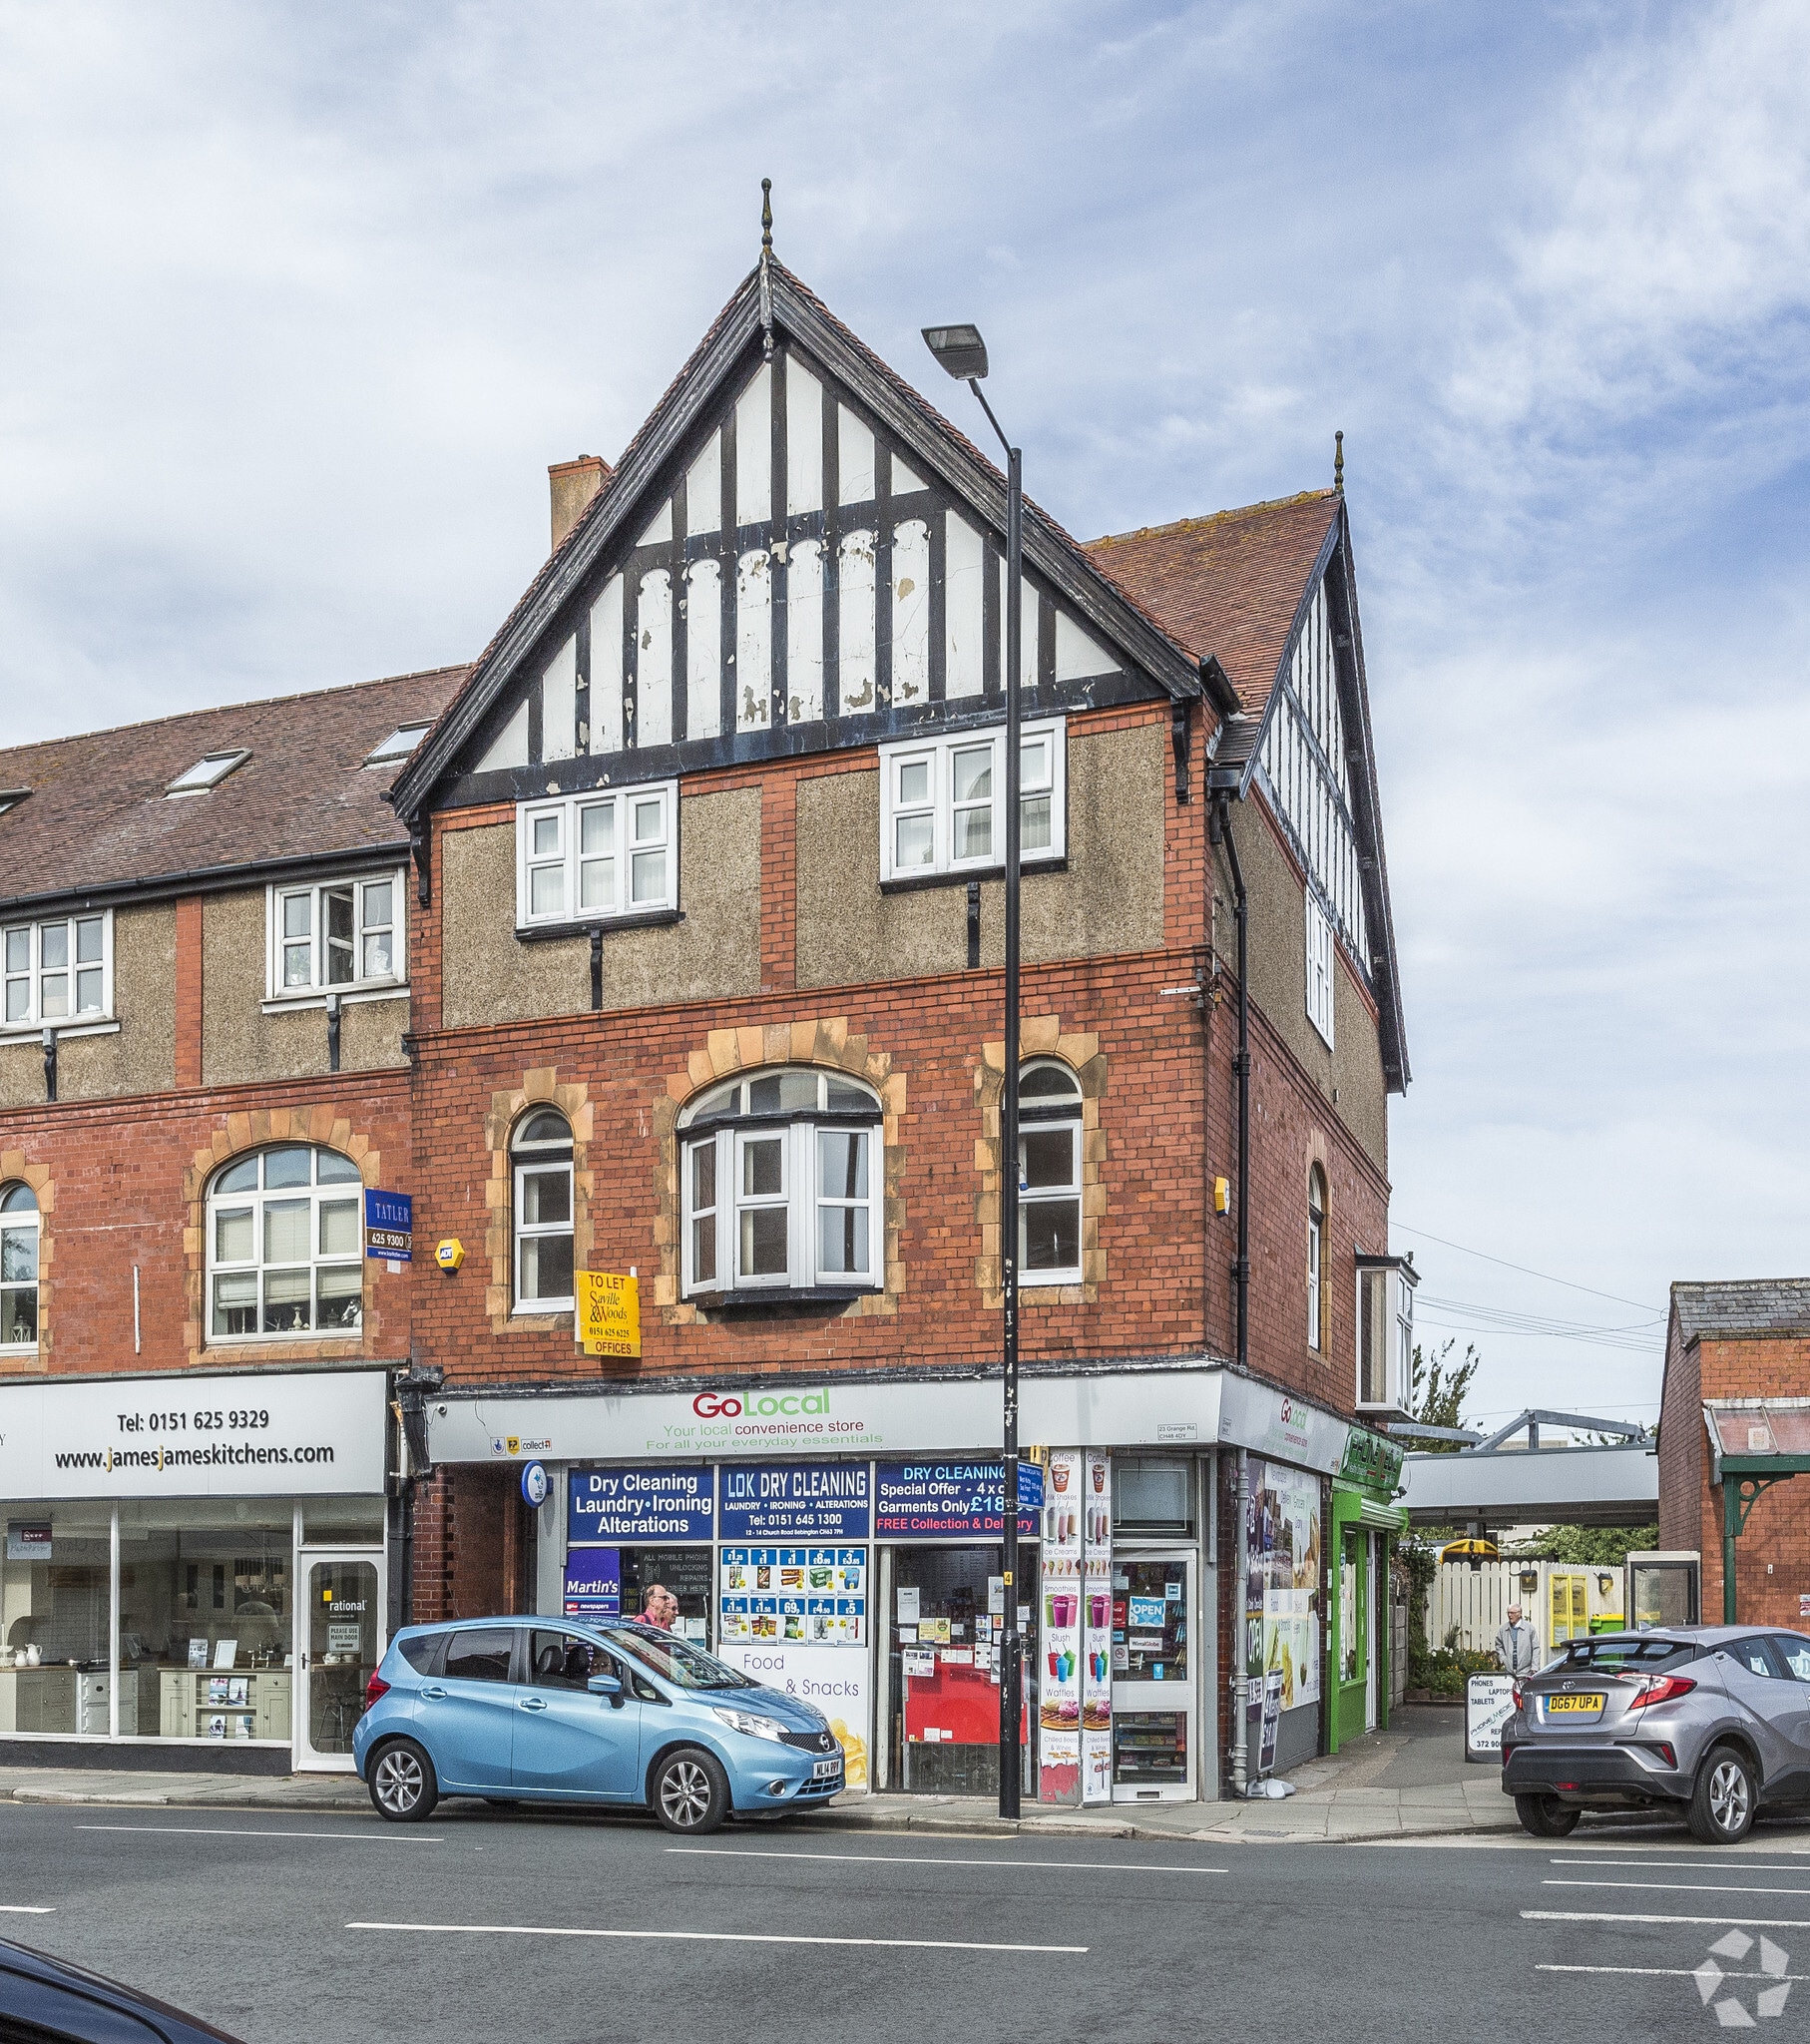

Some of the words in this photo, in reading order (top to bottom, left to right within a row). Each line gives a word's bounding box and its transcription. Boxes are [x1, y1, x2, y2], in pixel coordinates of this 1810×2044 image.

[375, 1203, 409, 1223] TATLER
[371, 1233, 385, 1245] 625
[386, 1234, 404, 1248] 9300
[589, 1275, 604, 1288] TO
[606, 1277, 626, 1289] LET
[589, 1289, 621, 1307] Saville
[589, 1326, 604, 1336] 0151
[605, 1327, 616, 1337] 625
[616, 1328, 630, 1338] 6225
[595, 1340, 632, 1354] OFFICES
[117, 1413, 145, 1432] Tel:
[149, 1412, 188, 1430] 0151
[193, 1410, 225, 1429] 625
[227, 1409, 270, 1428] 9329
[663, 1424, 696, 1438] Your
[699, 1423, 732, 1436] local
[734, 1421, 824, 1435] convenience
[827, 1419, 865, 1432] store
[646, 1440, 671, 1450] For
[674, 1438, 690, 1449] all
[694, 1439, 726, 1450] your
[731, 1436, 798, 1448] everyday
[801, 1433, 884, 1445] essentials
[55, 1442, 335, 1472] www.jamesjameskitchens.com
[903, 1466, 932, 1480] DRY
[590, 1475, 620, 1495] Dry
[623, 1473, 697, 1494] Cleaning
[727, 1473, 755, 1498] LOK
[760, 1472, 788, 1497] DRY
[793, 1470, 866, 1497] CLEANING
[880, 1483, 926, 1498] Special
[928, 1483, 961, 1495] Offer
[977, 1483, 986, 1494] 4
[988, 1484, 996, 1494] x
[576, 1495, 645, 1516] Laundry
[653, 1494, 712, 1515] Ironing
[724, 1501, 761, 1511] LAUNDRY
[769, 1500, 806, 1510] IRONING
[815, 1499, 869, 1509] ALTERATIONS
[878, 1500, 940, 1513] Garments
[941, 1499, 971, 1515] Only
[597, 1515, 689, 1534] Alterations
[748, 1515, 766, 1526] Tel:
[767, 1514, 792, 1526] 0151
[795, 1513, 815, 1525] 645
[817, 1513, 842, 1525] 1300
[876, 1518, 908, 1530] FREE
[910, 1518, 969, 1529] Collection
[972, 1518, 981, 1529] &
[984, 1517, 1034, 1532] Delery
[659, 1553, 682, 1562] MOBILE
[759, 1552, 767, 1564] £1
[787, 1552, 796, 1564] £1
[1005, 1573, 1011, 1584] 4
[566, 1580, 619, 1594] Martin's
[329, 1600, 366, 1612] rational
[845, 1603, 856, 1615] £5
[1132, 1604, 1162, 1616] OPEN
[1051, 1633, 1071, 1643] Slush
[1092, 1633, 1106, 1643] Slush
[743, 1654, 785, 1671] Food
[785, 1678, 797, 1695] &
[802, 1679, 859, 1697] Snacks
[1045, 1688, 1075, 1698] Waffles
[1551, 1697, 1578, 1710] DG67
[1579, 1697, 1598, 1709] UPA
